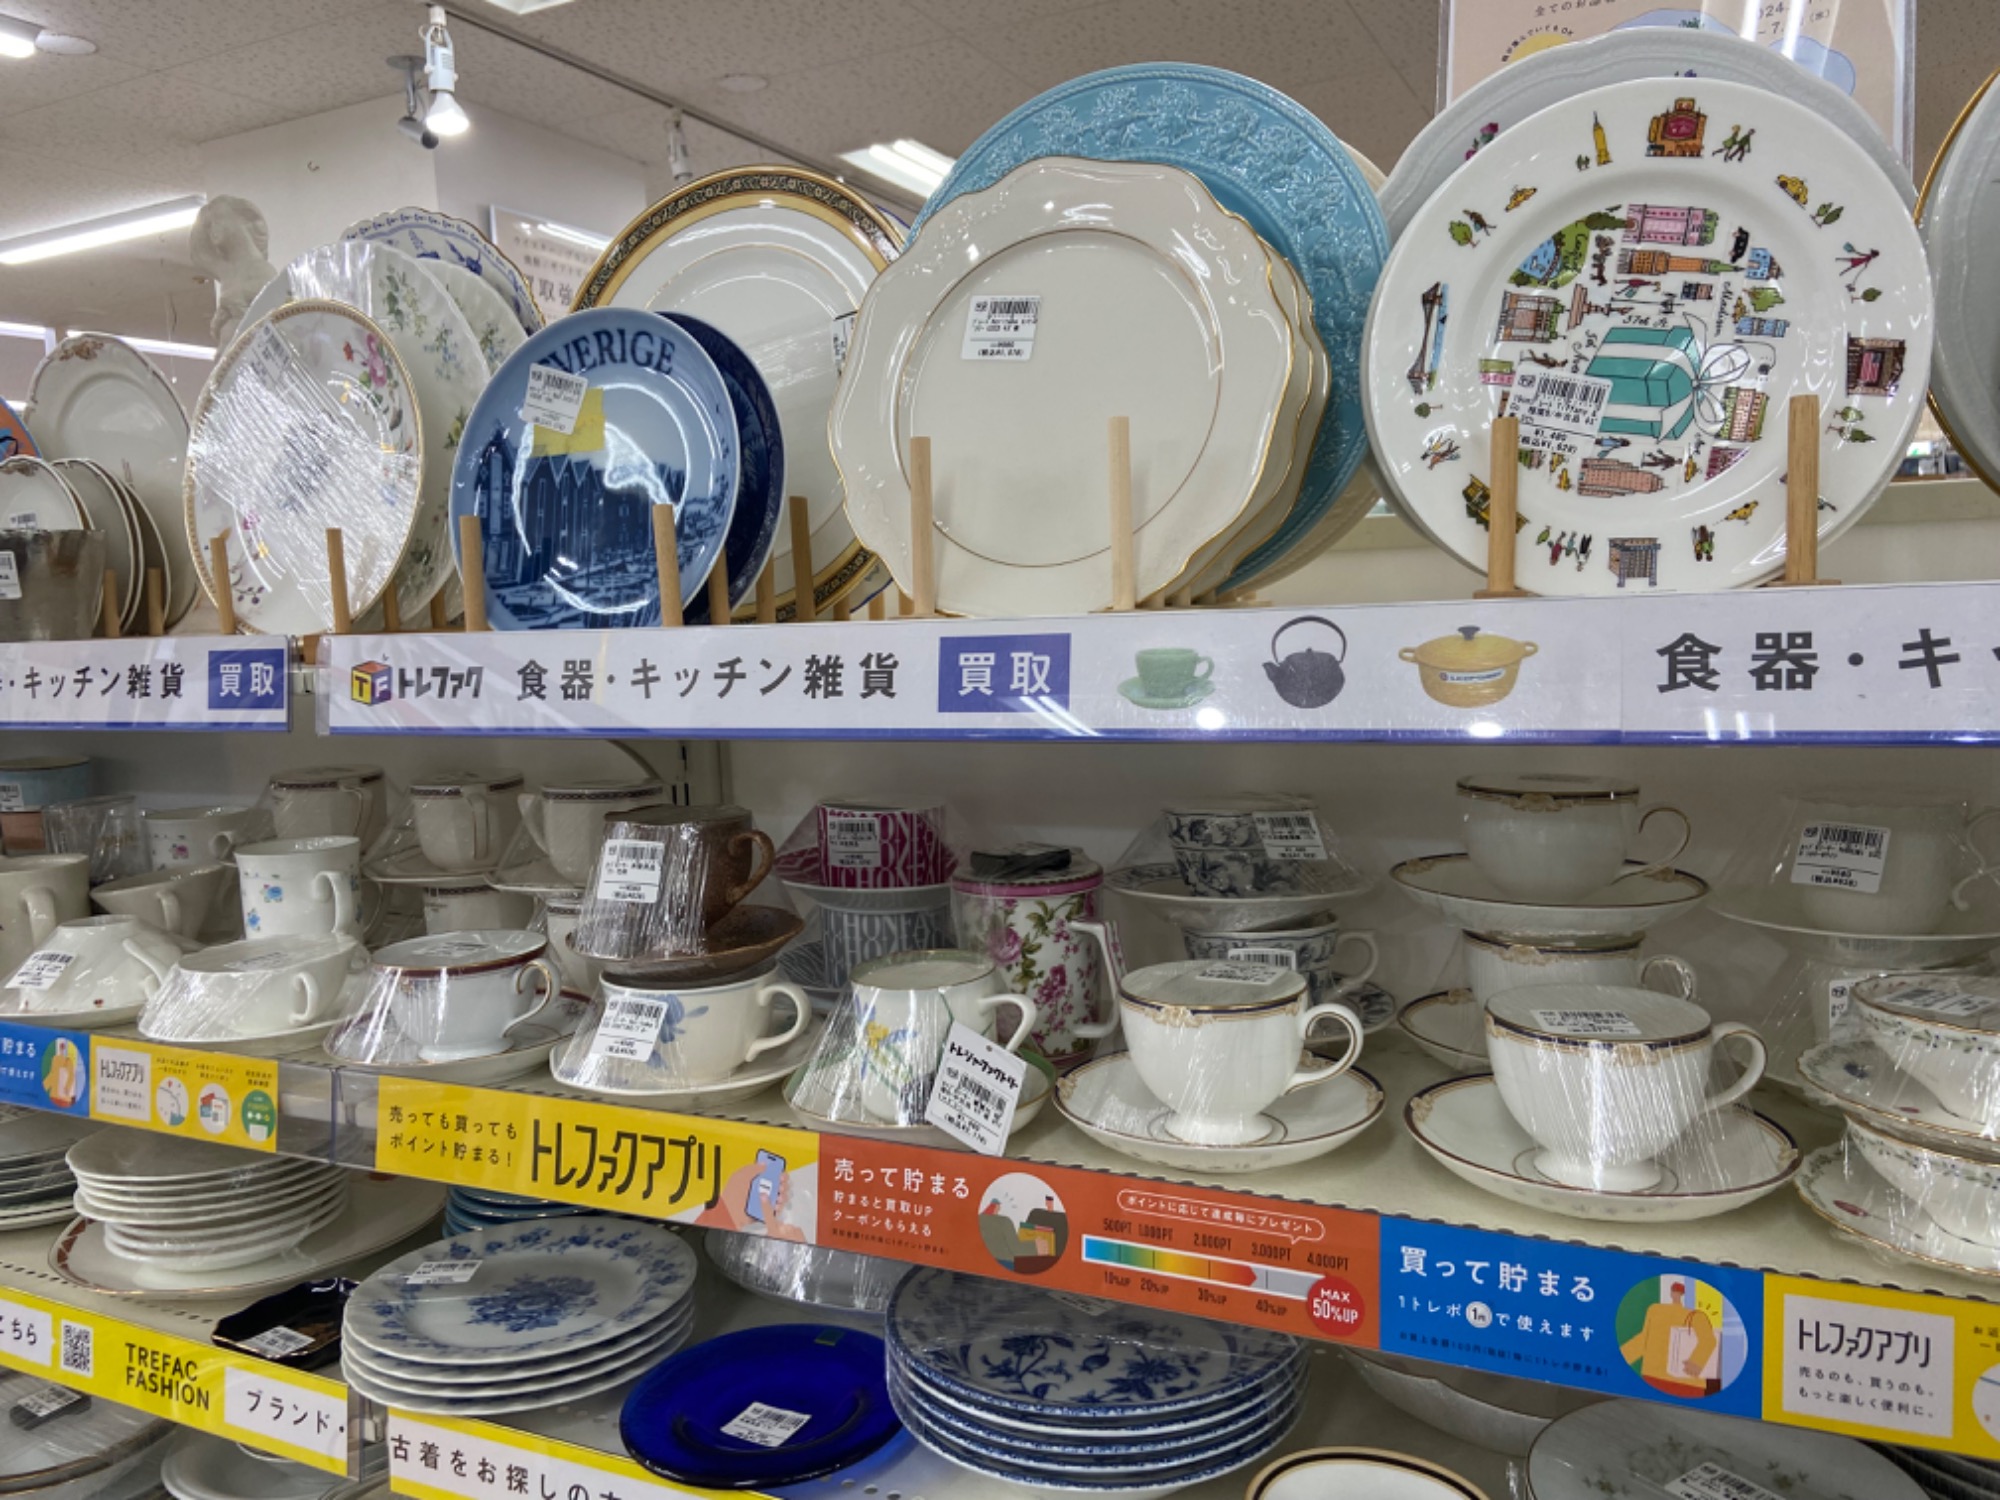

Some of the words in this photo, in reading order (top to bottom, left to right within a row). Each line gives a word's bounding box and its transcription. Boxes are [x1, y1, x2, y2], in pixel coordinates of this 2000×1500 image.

[537, 328, 676, 376] VERIGE
[516, 651, 900, 701] 食器・キッチン雑貨
[957, 651, 1053, 696] 買取
[1656, 627, 2000, 693] 食器・キ
[0, 662, 185, 700] ・キッチン雑貨
[219, 663, 275, 698] 買取
[398, 665, 483, 699] トレファク
[388, 1105, 518, 1140] 売っても買っても
[531, 1118, 722, 1209] トレファクアプリ
[834, 1158, 970, 1199] 売って貯まる
[832, 1190, 934, 1217] 貯まると買取UP
[832, 1209, 932, 1237] クーポンもらえる
[1400, 1245, 1595, 1302] 買って貯まる
[1312, 1300, 1358, 1325] 50%UP
[1320, 1288, 1350, 1302] MAX
[125, 1342, 198, 1382] TREFAC
[1799, 1318, 1931, 1369] トレファクアプリ
[126, 1367, 210, 1411] FASHION
